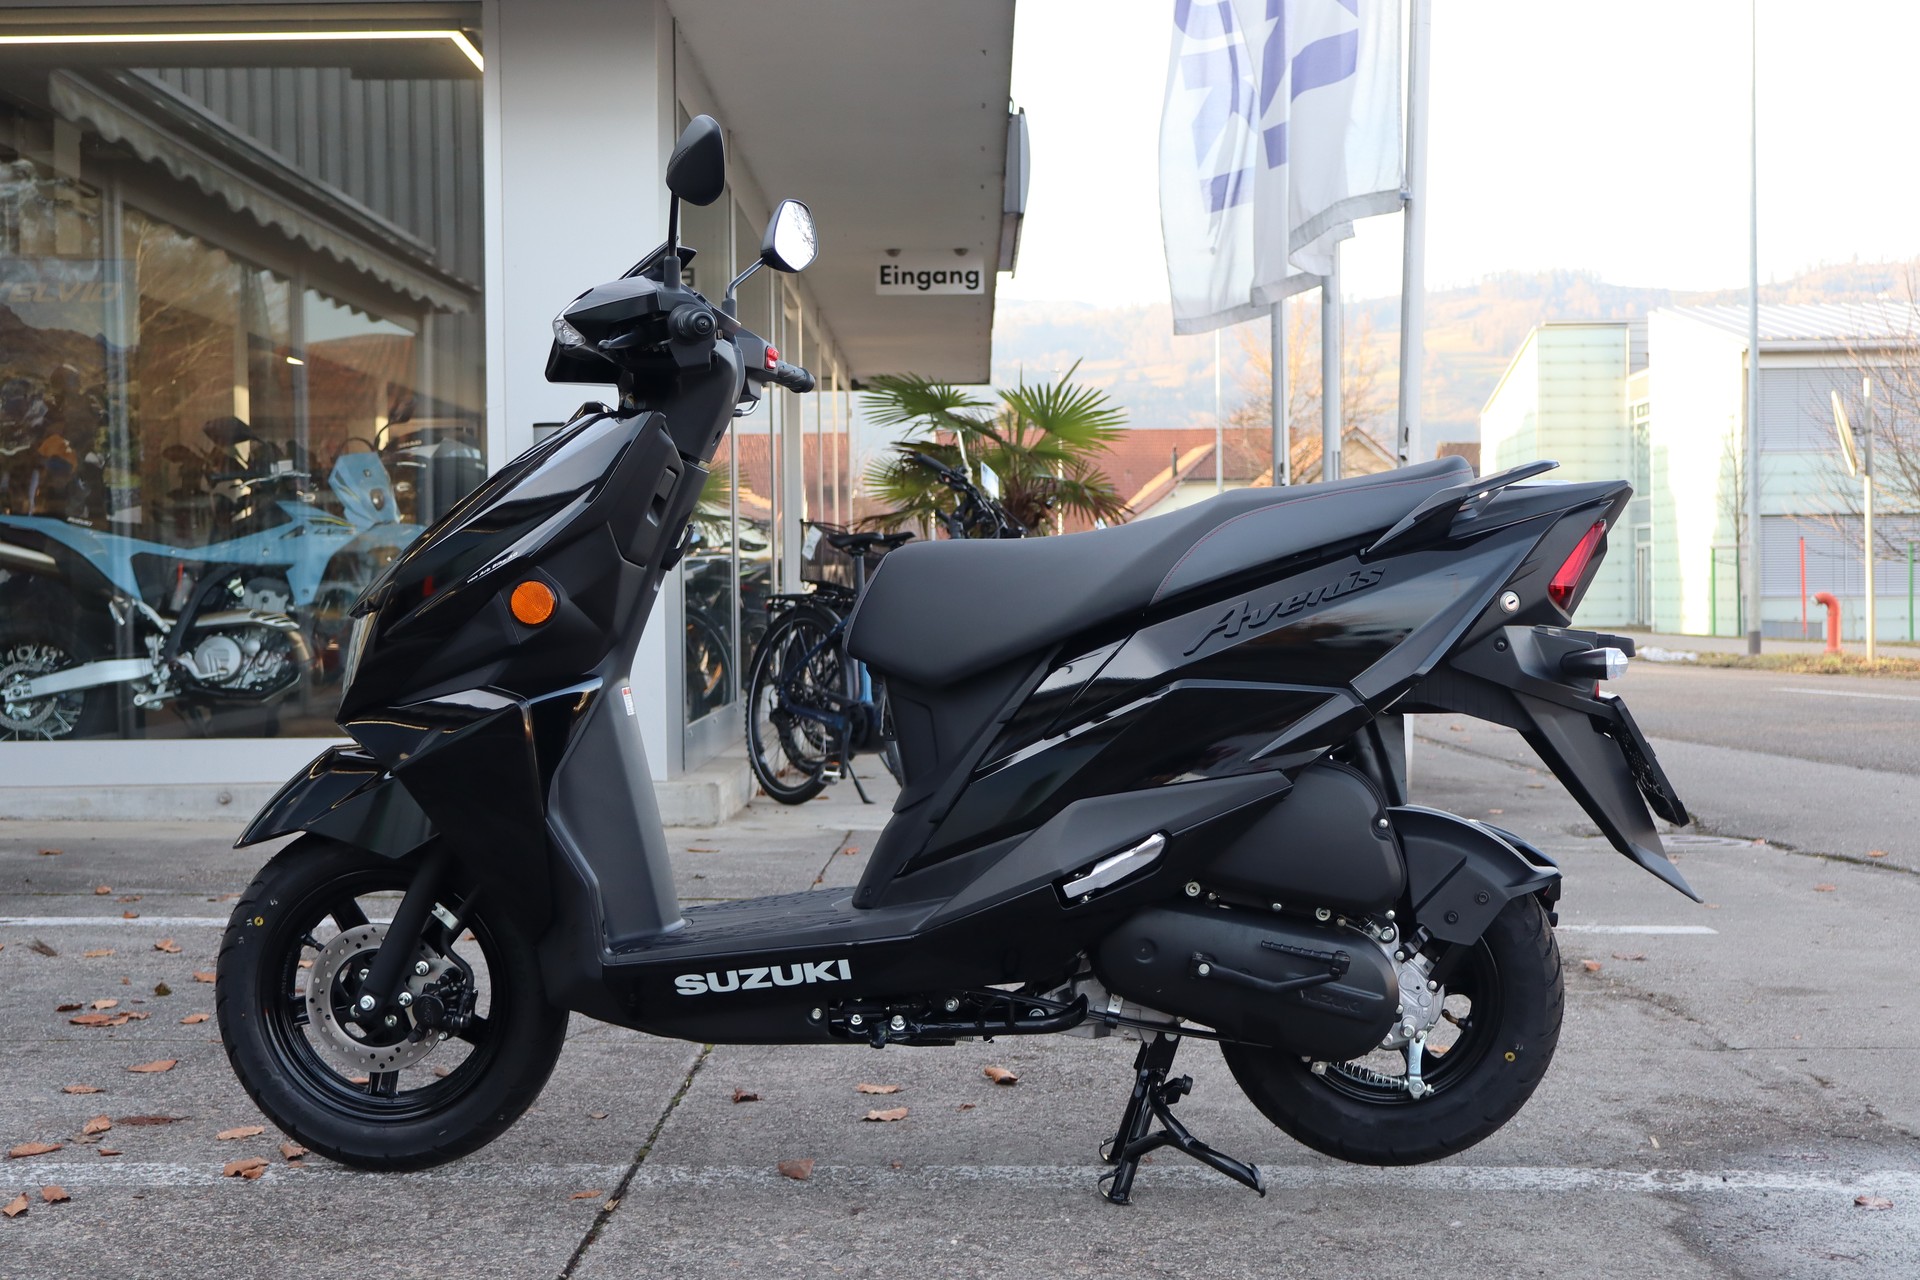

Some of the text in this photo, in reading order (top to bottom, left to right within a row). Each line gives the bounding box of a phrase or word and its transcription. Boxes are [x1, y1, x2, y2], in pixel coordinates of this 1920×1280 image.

[880, 265, 979, 291] Eingang
[1183, 567, 1386, 656] Avenis
[674, 959, 852, 996] SUZUKI
